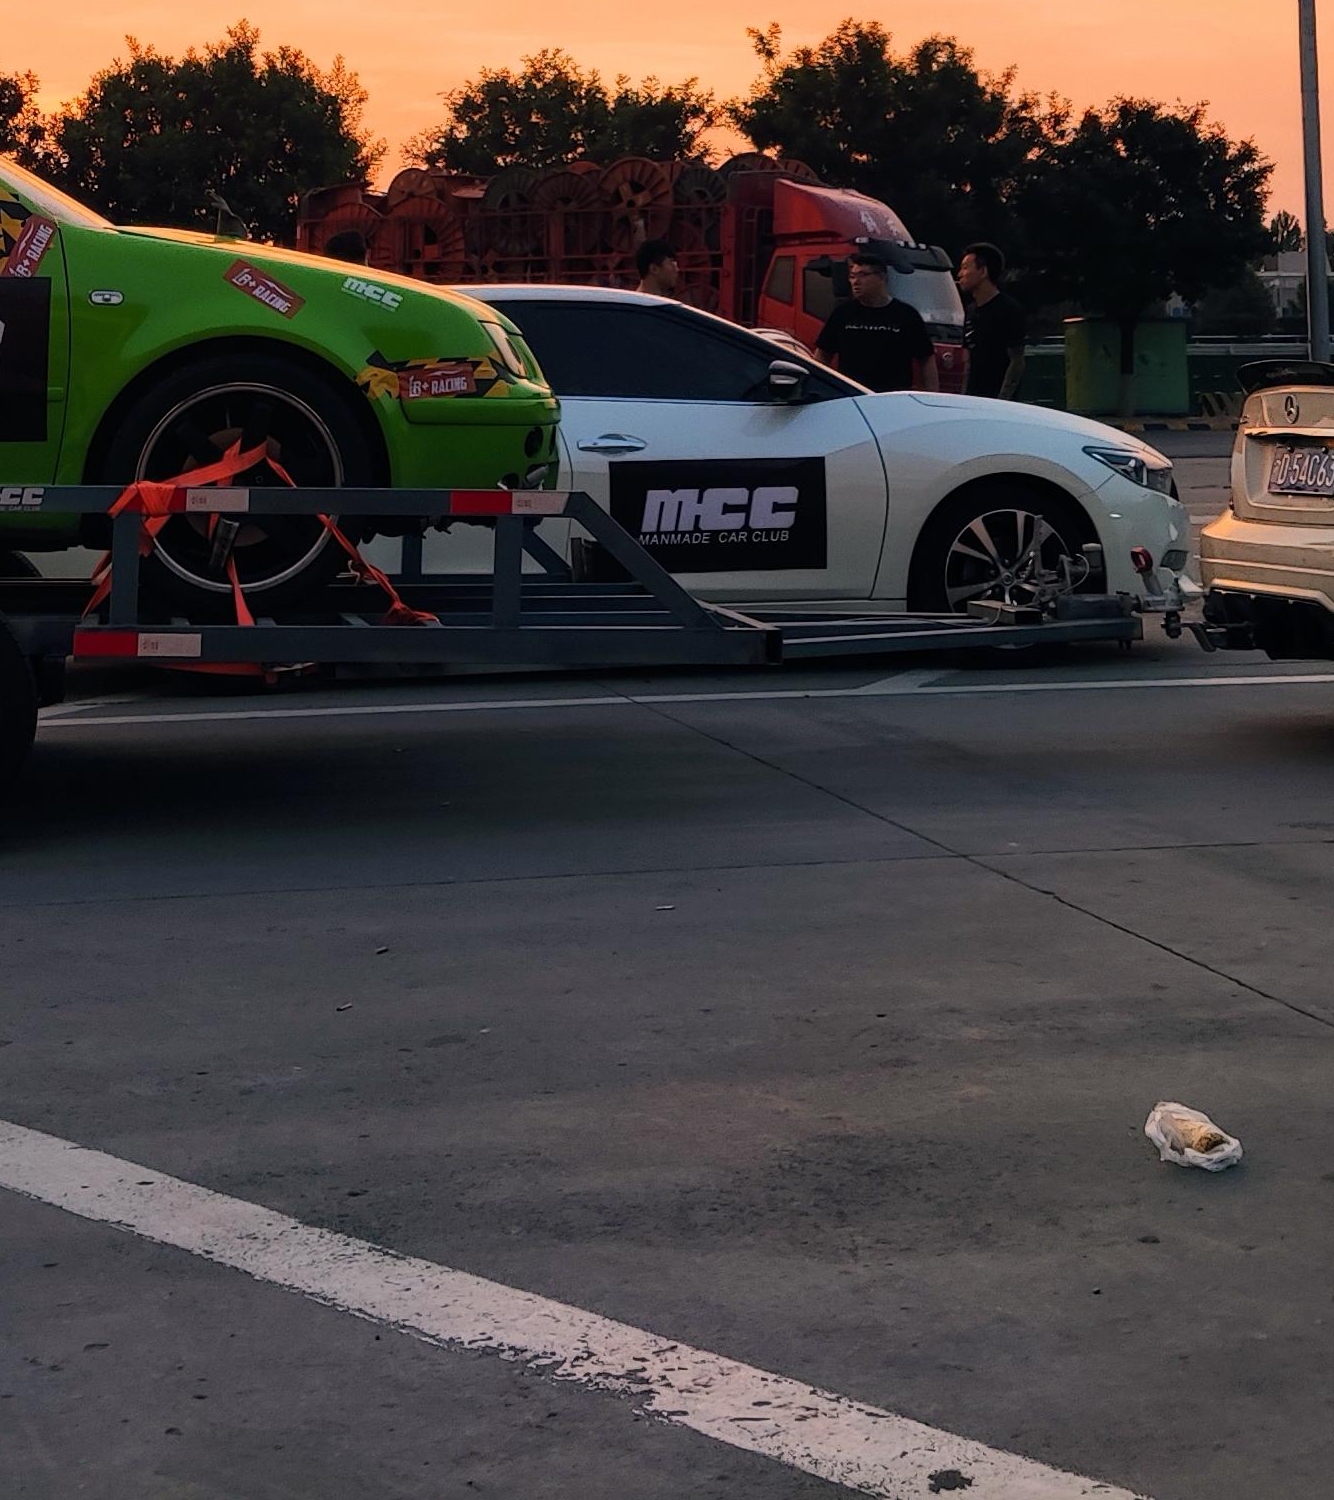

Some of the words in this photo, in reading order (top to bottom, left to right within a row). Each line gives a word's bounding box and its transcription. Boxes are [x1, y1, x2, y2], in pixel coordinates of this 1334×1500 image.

[26, 224, 54, 261] RACING
[252, 285, 292, 313] RACING
[431, 376, 468, 395] RACING
[641, 486, 799, 532] MCC
[638, 532, 712, 546] MANMADE
[718, 531, 748, 544] CAR
[752, 530, 790, 543] CLUB
